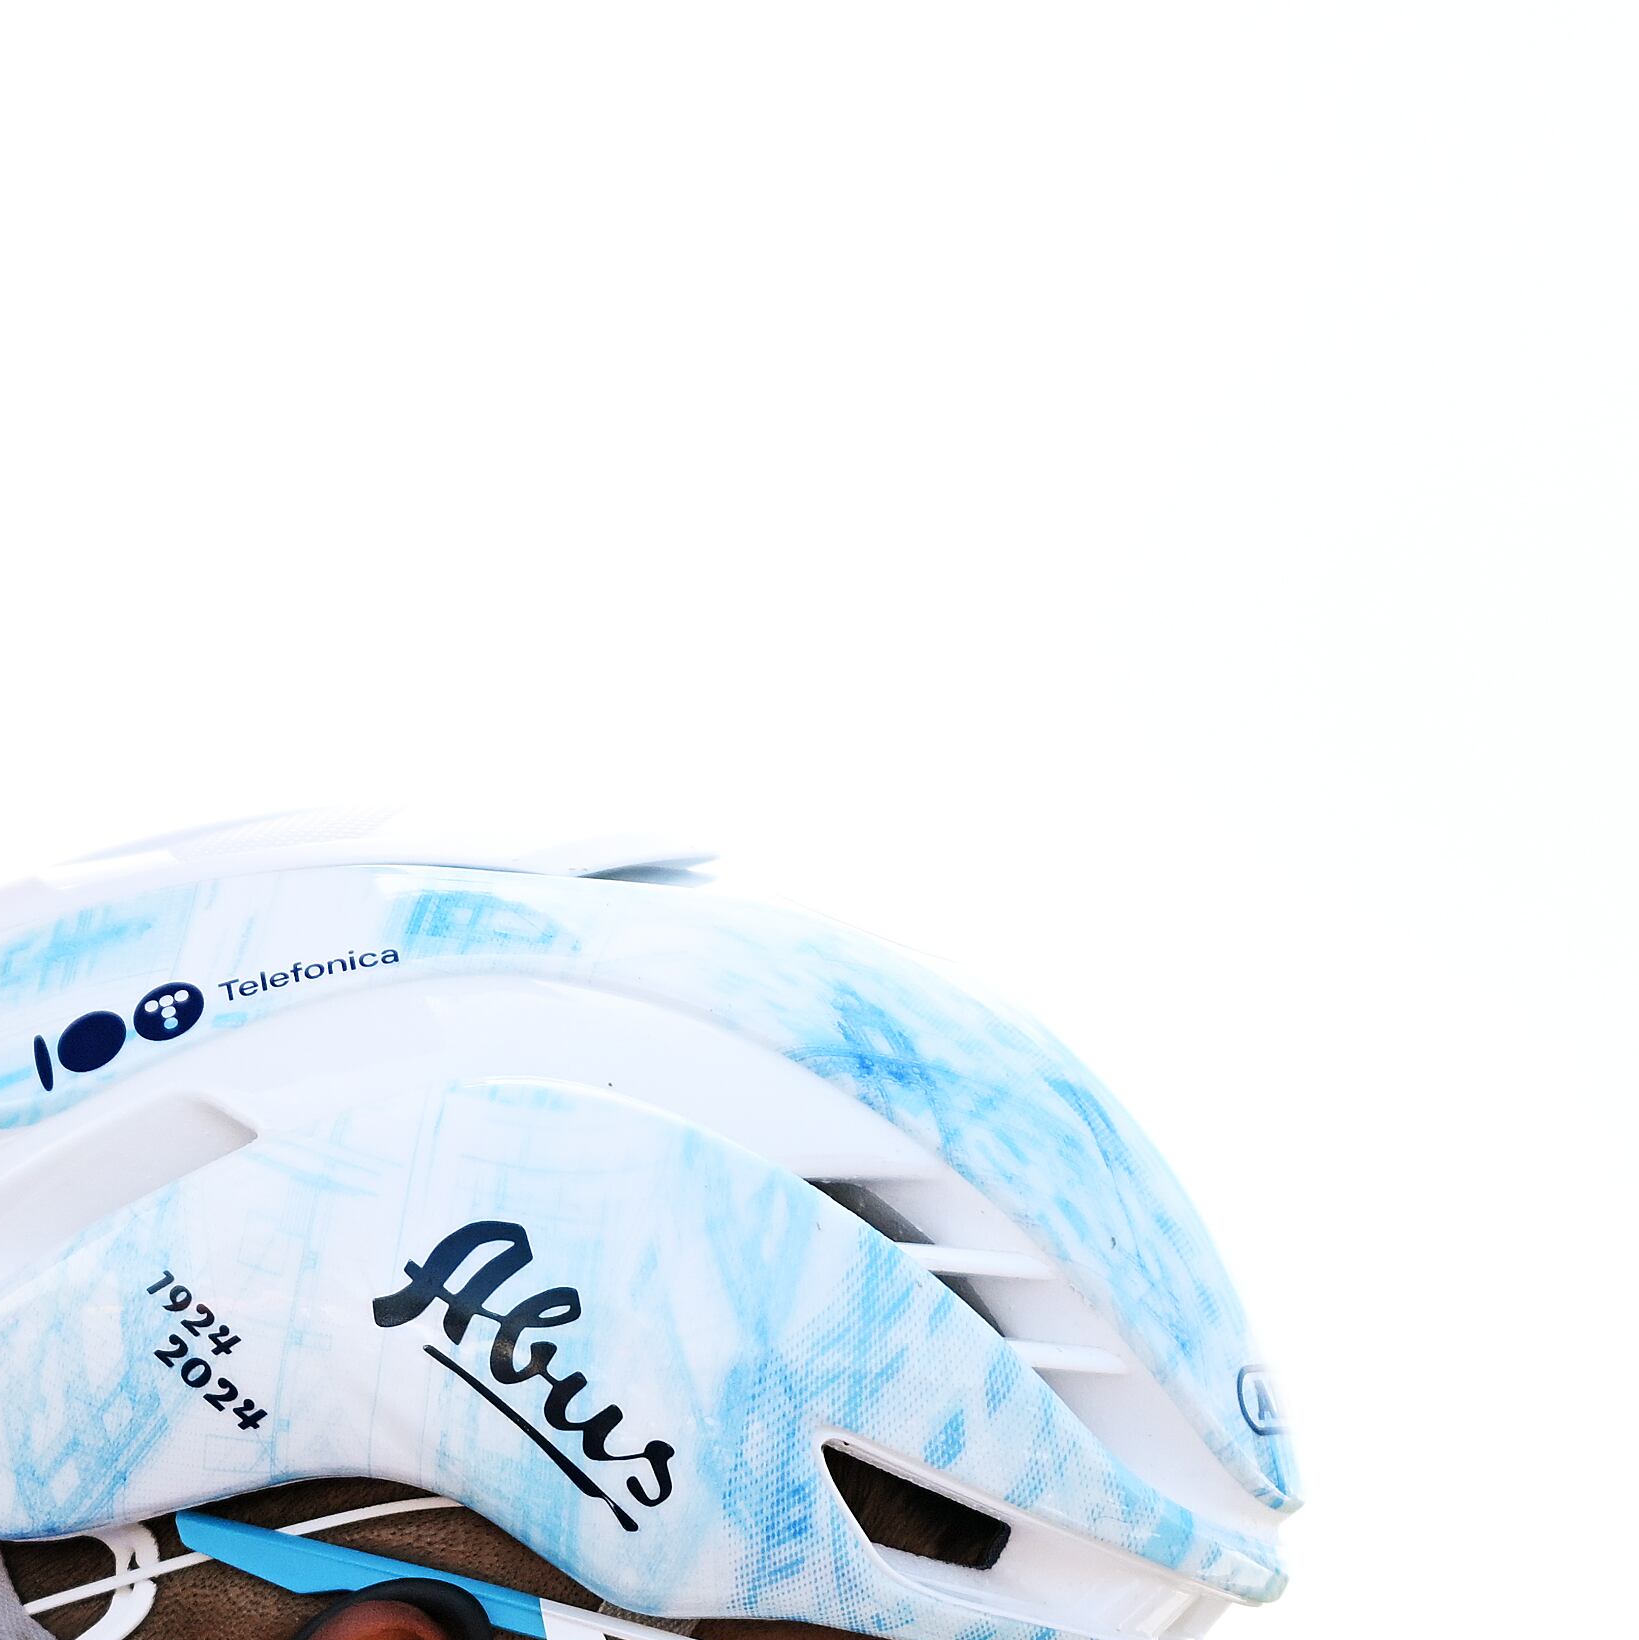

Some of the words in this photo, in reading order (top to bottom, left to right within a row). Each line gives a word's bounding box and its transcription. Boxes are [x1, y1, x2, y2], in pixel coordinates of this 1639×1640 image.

[217, 949, 400, 1001] Telefonica
[146, 1270, 242, 1356] 1924
[153, 1333, 268, 1431] 2024
[372, 1220, 676, 1508] Abus
